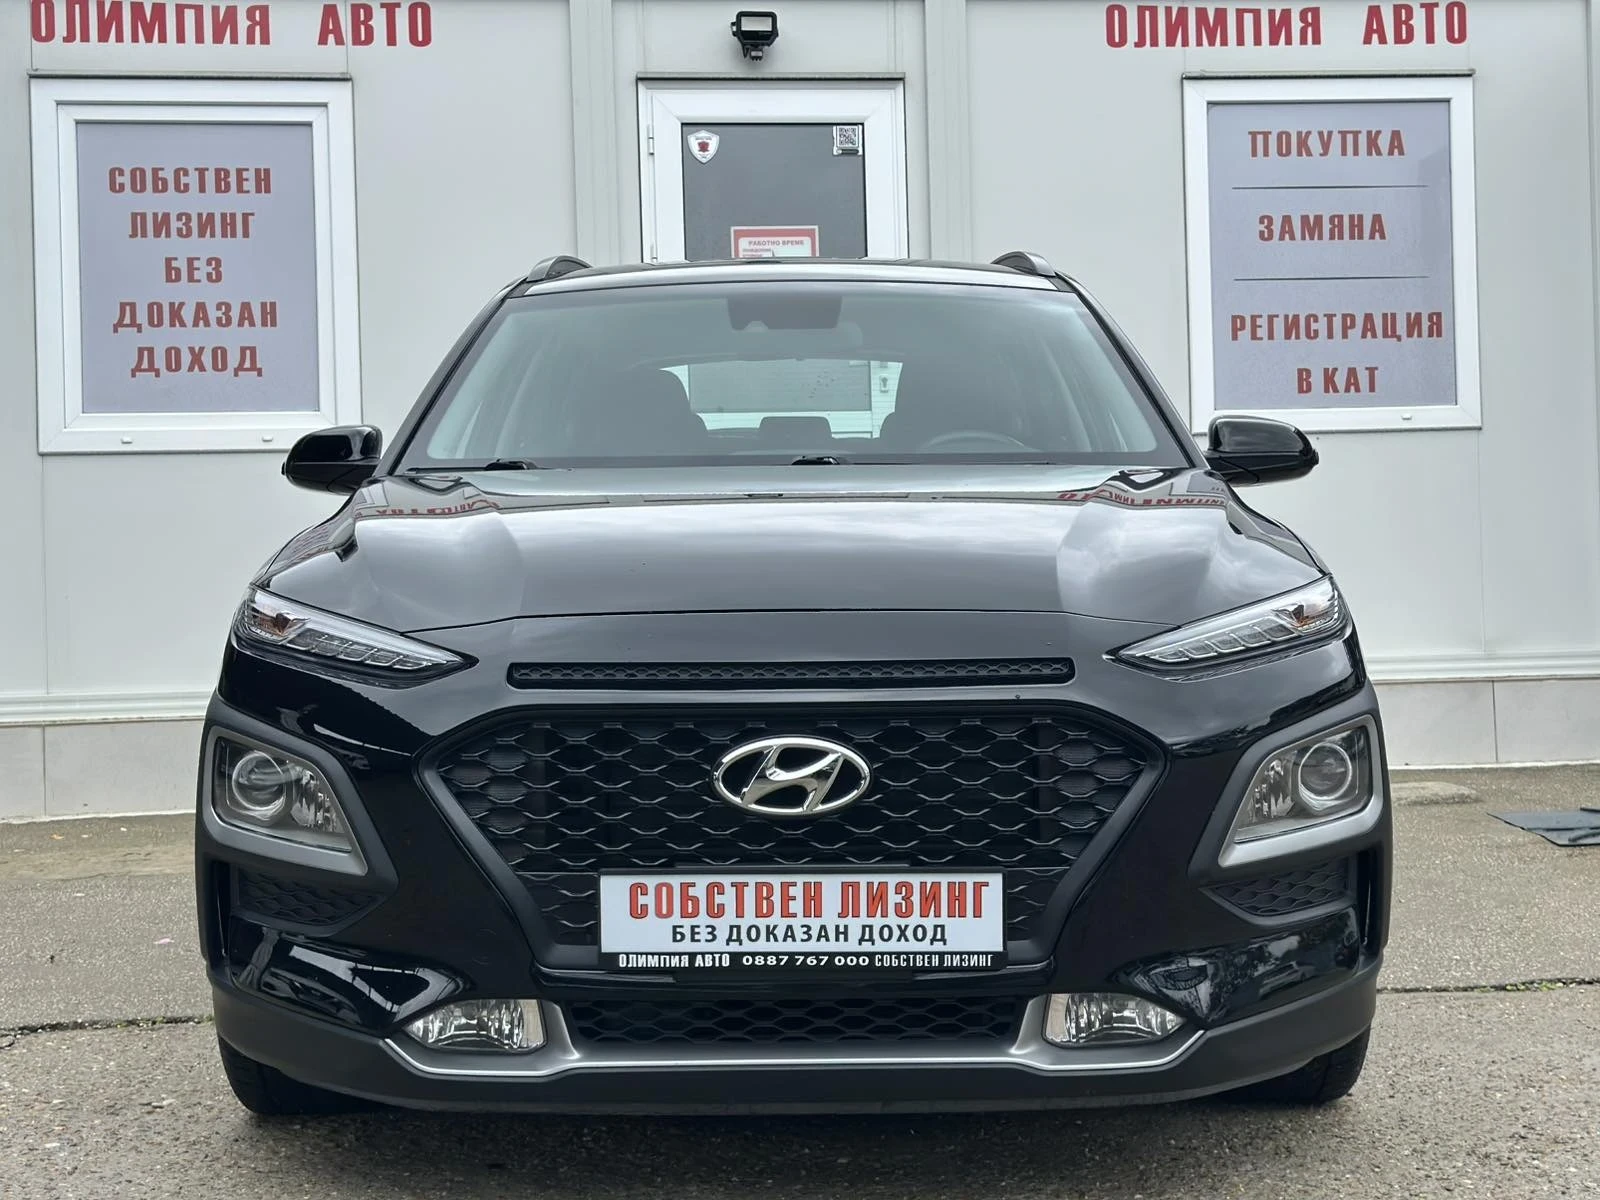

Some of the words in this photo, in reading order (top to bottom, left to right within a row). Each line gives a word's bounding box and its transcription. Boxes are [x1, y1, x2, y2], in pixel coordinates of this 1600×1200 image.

[31, 0, 271, 45] ОЛИМПИЯ
[317, 1, 432, 47] АВТО
[1105, 4, 1322, 48] ОЛИМПИЯ
[1363, 1, 1468, 45] АВТО
[1248, 130, 1405, 158] ПОКУПКА
[108, 167, 272, 194] СОБСТВЕН
[128, 212, 255, 239] ЛИЗИНГ
[1258, 214, 1386, 242] ЗАМЯНА
[164, 256, 223, 283] БЕЗ
[113, 301, 278, 333] ДОКАЗАН
[1231, 312, 1443, 342] РЕГИСТРАЦИЯ
[131, 345, 263, 378] ДОХОД
[1296, 367, 1313, 395] В
[1323, 366, 1379, 394] КАТ
[629, 882, 823, 919] СОБСТВЕН
[837, 881, 990, 919] ЛИЗИНГ
[671, 924, 718, 943] БЕЗ
[726, 924, 850, 946] ДОКАЗАН
[858, 924, 947, 946] ДОХОД
[618, 953, 689, 968] ОЛИМПИЯ
[695, 953, 731, 968] АВТО
[742, 955, 789, 966] 0887
[795, 955, 829, 966] 767
[834, 955, 870, 966] 000
[874, 954, 940, 967] СОБСТВЕН
[943, 954, 994, 967] ЛИЗИНГ
